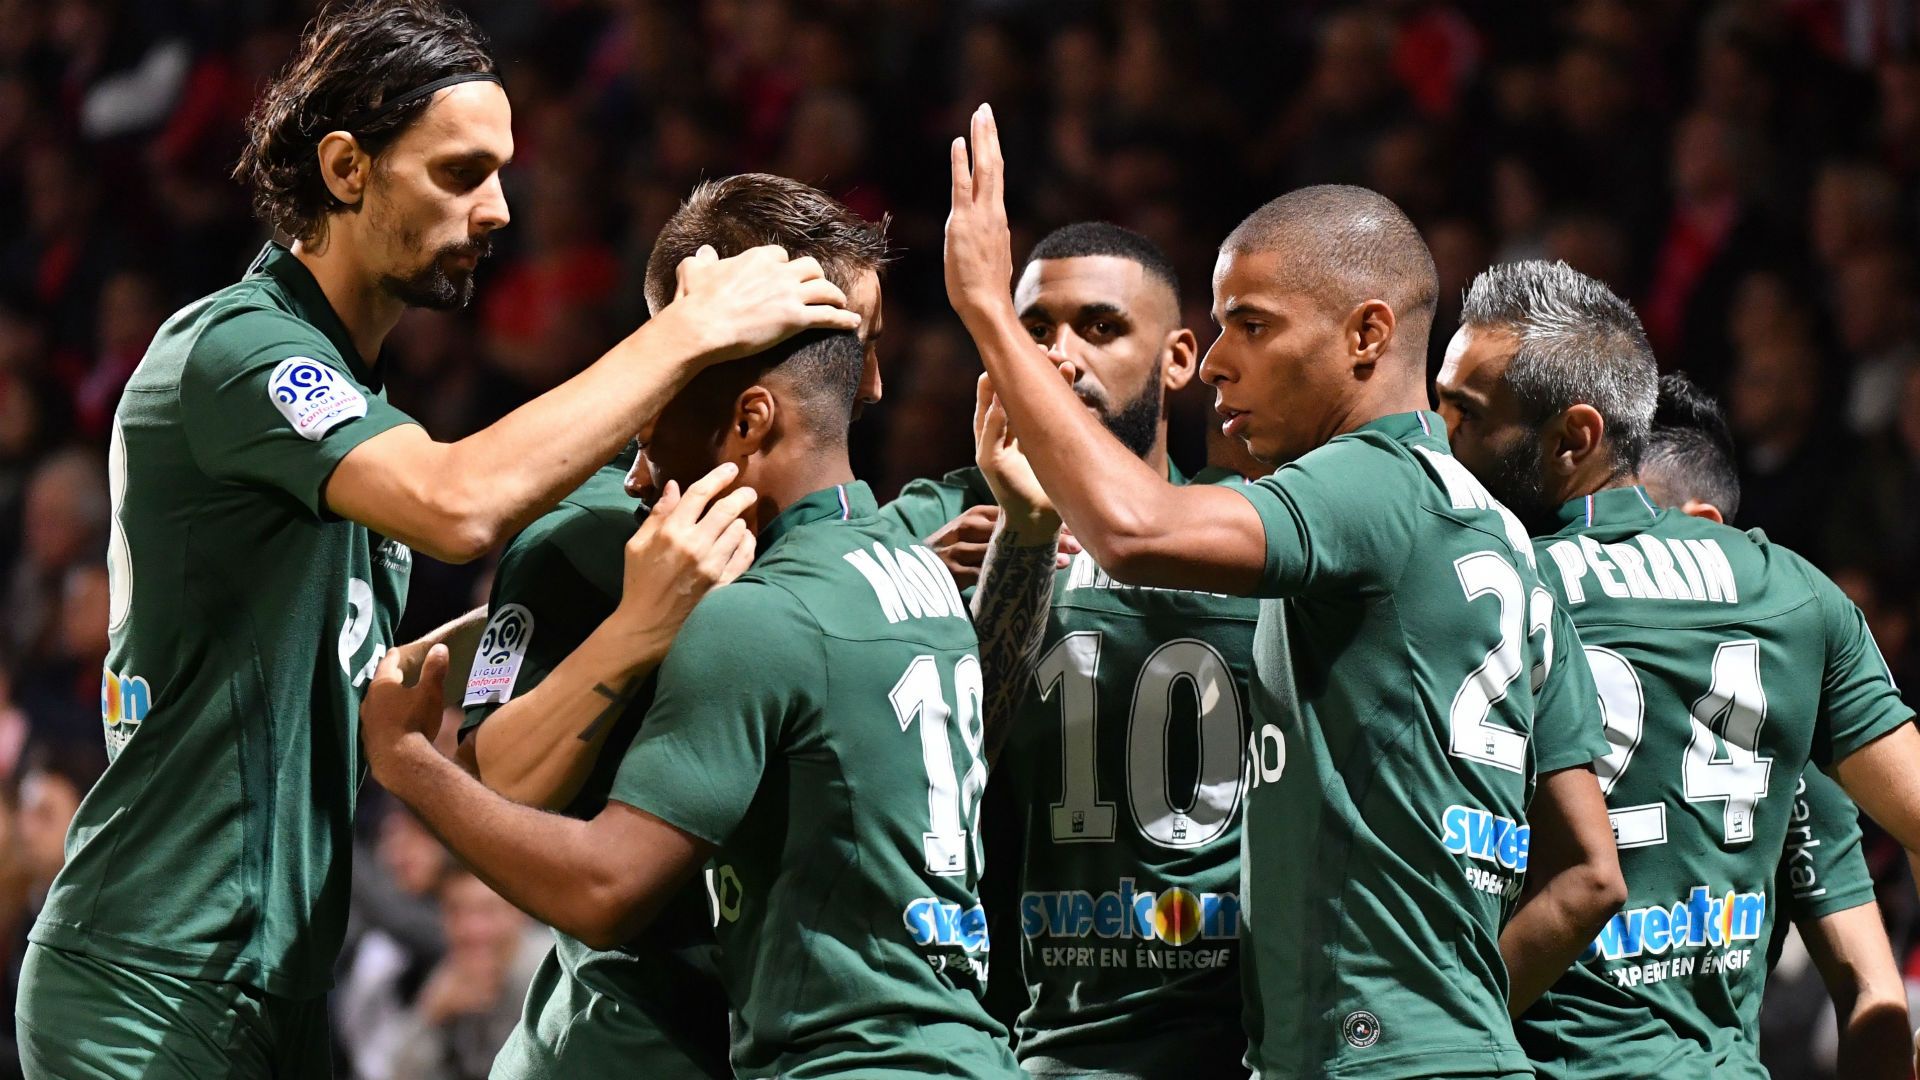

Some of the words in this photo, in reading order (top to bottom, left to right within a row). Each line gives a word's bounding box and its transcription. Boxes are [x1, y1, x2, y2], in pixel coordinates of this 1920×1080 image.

[1547, 535, 1738, 604] PERRIN
[473, 667, 502, 677] LIGUE
[1034, 631, 1245, 849] 10
[1578, 885, 1766, 965] weetcom
[1101, 948, 1128, 968] EN
[1136, 942, 1232, 969] ÉNERGIE
[1671, 957, 1695, 977] EN
